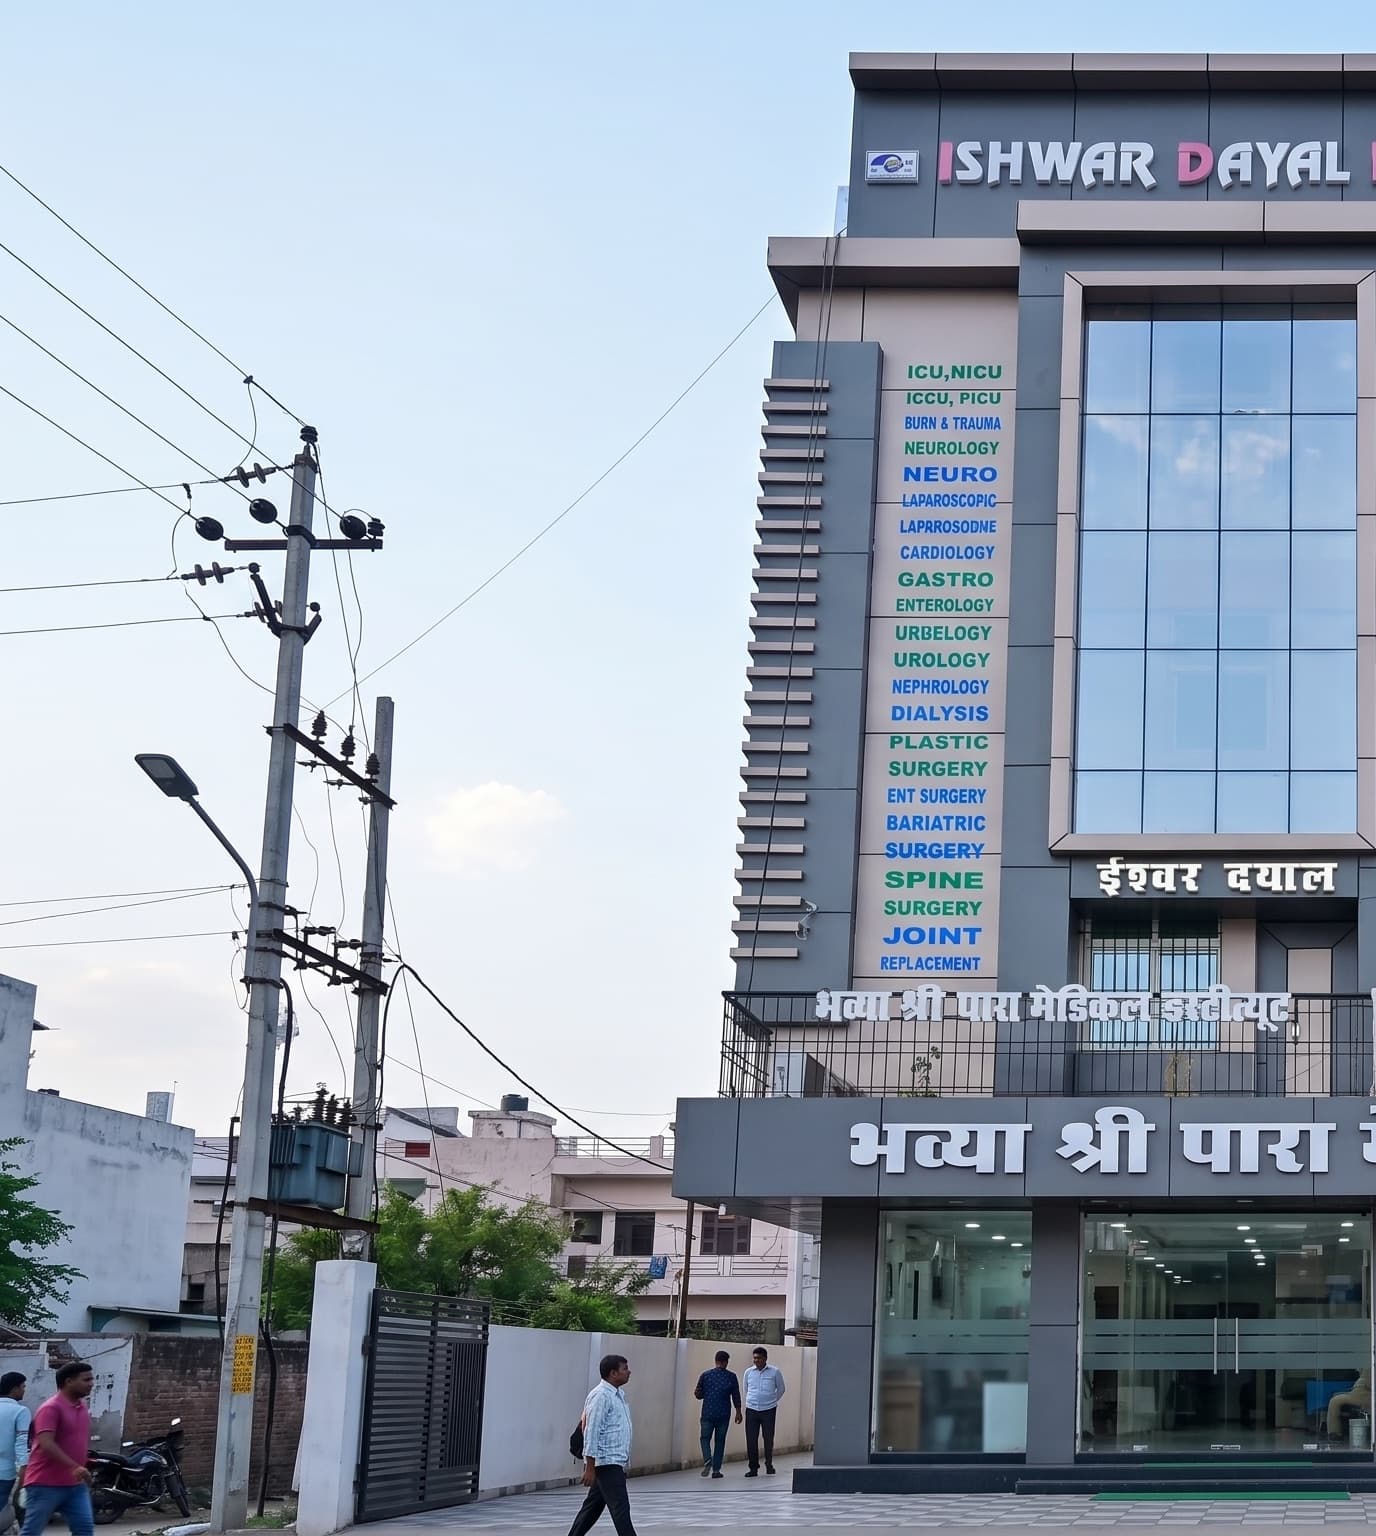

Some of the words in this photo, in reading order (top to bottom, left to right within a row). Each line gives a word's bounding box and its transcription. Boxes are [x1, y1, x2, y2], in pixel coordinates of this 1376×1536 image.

[938, 141, 1157, 190] ISHWAR
[1177, 141, 1351, 190] DAYAL
[907, 365, 1002, 382] ICU,NICU
[906, 392, 954, 407] ICCU,
[959, 392, 1001, 405] PICU
[904, 416, 937, 430] BURN
[940, 416, 949, 430] &
[953, 416, 1001, 430] TRAUMA
[904, 441, 1000, 455] NEUROLOGY
[903, 467, 998, 482] NEURO
[902, 493, 997, 508] LAPAROSCOPIC
[900, 545, 995, 560] CARDIOLOGY
[898, 572, 994, 587] GASTRO
[896, 598, 994, 612] ENTEROLOGY
[894, 652, 990, 668] UROLOGY
[892, 679, 989, 694] NEPHROLOGY
[891, 705, 989, 721] DIALYSIS
[889, 735, 989, 750] PLASTIC
[888, 761, 988, 777] SURGERY
[887, 788, 915, 804] ENT
[920, 788, 987, 804] SURGERY
[887, 815, 986, 831] BARIATRIC
[885, 842, 985, 859] SURGERY
[885, 871, 983, 889] SPINE
[1096, 857, 1202, 897] ईश्वर
[1223, 863, 1338, 894] दयाल
[884, 900, 982, 916] SURGERY
[883, 927, 982, 945] JOINT
[881, 956, 981, 971] REPLACEMENT
[849, 1121, 1033, 1174] भव्या
[1055, 1106, 1155, 1173] श्री
[1179, 1122, 1337, 1173] पारा
